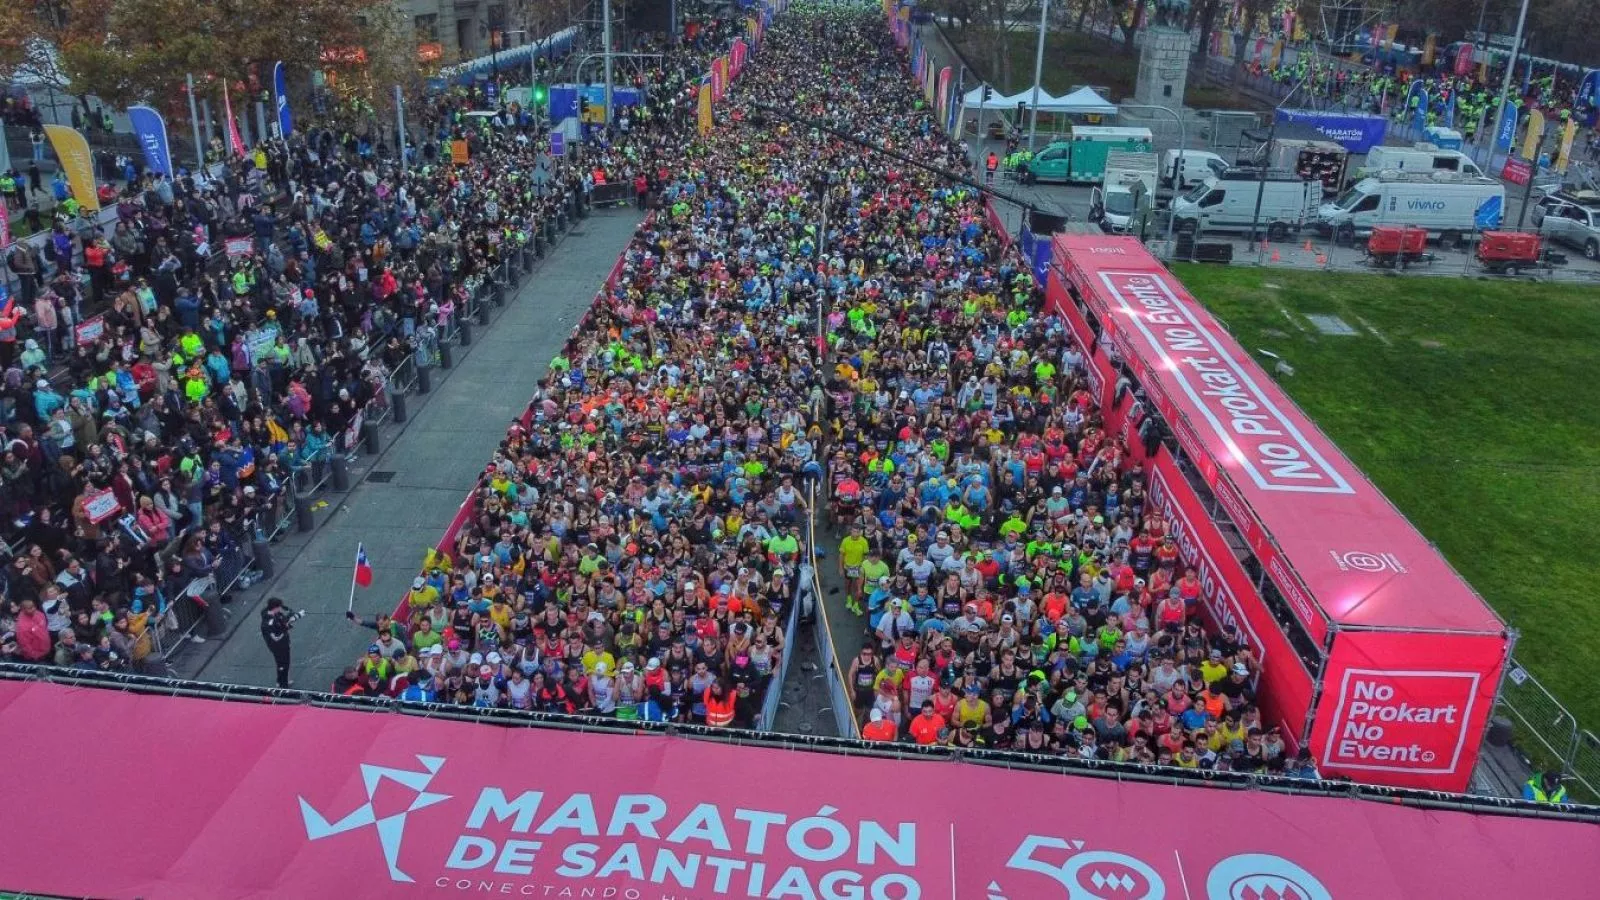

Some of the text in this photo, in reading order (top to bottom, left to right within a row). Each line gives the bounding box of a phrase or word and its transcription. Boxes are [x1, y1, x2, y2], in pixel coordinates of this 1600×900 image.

[1124, 284, 1186, 325] Event
[1164, 328, 1209, 352] No
[1182, 356, 1283, 436] Prokart
[1258, 442, 1323, 480] No
[1152, 478, 1164, 508] No
[1164, 499, 1198, 566] Prokart
[1200, 558, 1215, 598] No
[1353, 680, 1394, 701] No
[1348, 701, 1457, 724] Prokart
[1343, 721, 1384, 741] No
[1338, 740, 1422, 762] Event
[465, 786, 917, 867] MARATÓN
[445, 834, 922, 900] DE SANTIAGO
[434, 876, 641, 900] CONECTANDO
